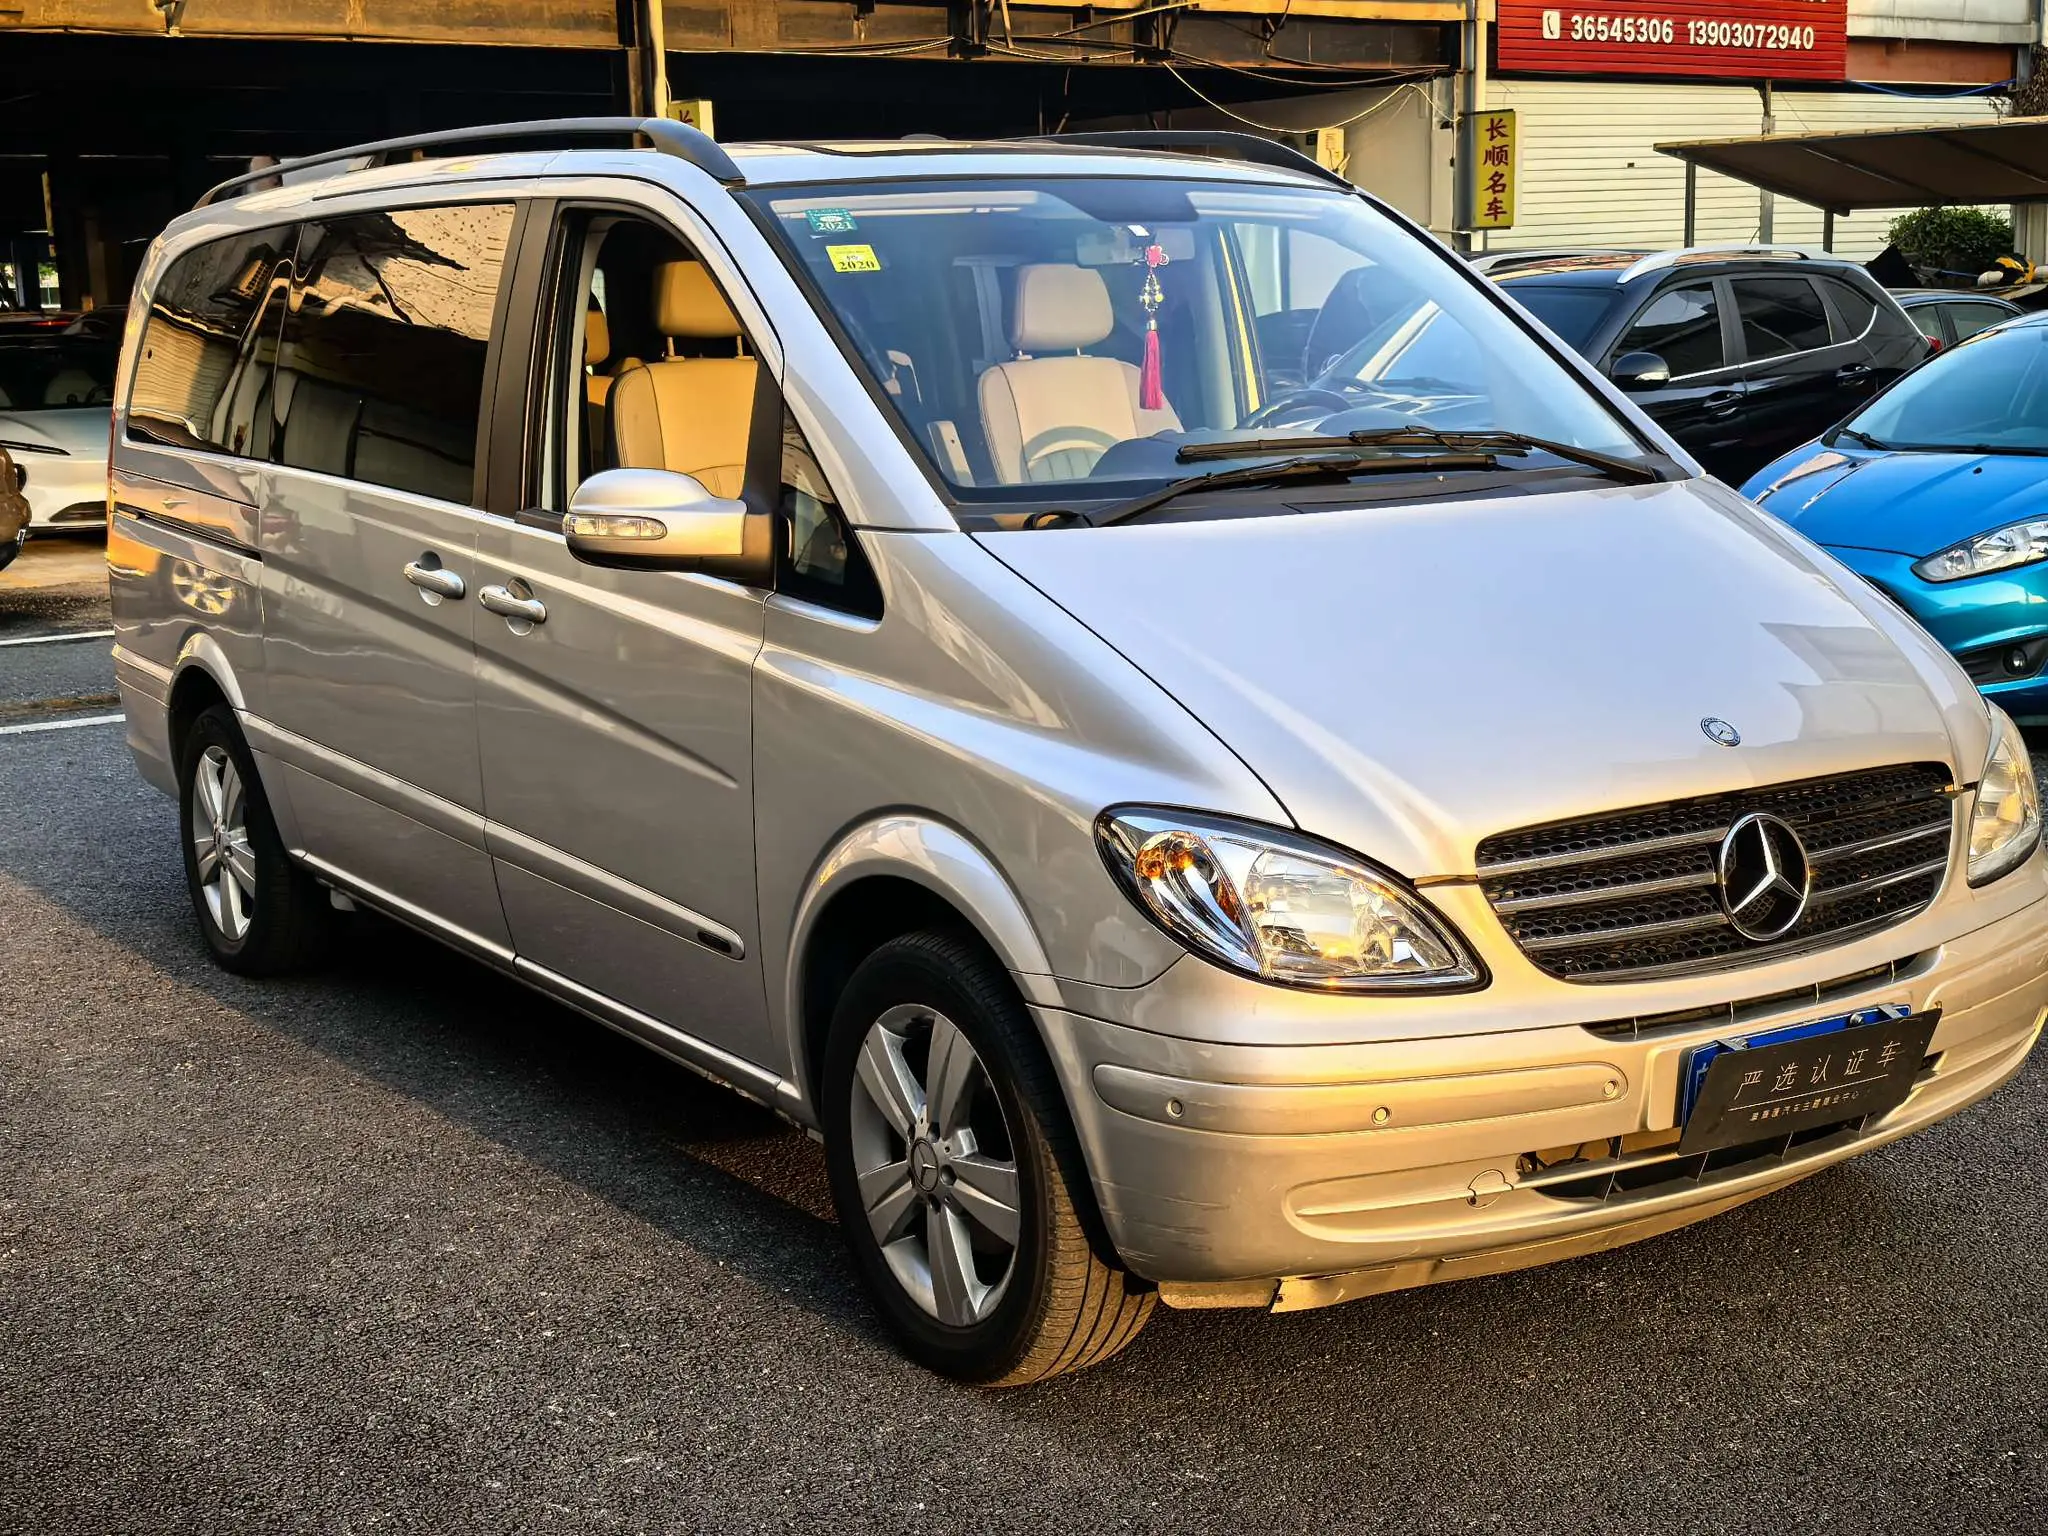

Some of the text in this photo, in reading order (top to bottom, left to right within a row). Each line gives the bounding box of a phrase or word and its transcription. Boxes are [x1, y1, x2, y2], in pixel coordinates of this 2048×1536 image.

[1571, 15, 1815, 50] 36545306 13903072940
[1483, 118, 1509, 222] 长顺名车
[816, 221, 854, 231] 2021
[838, 260, 875, 270] 2020
[1734, 1040, 1901, 1100] 严选认证车
